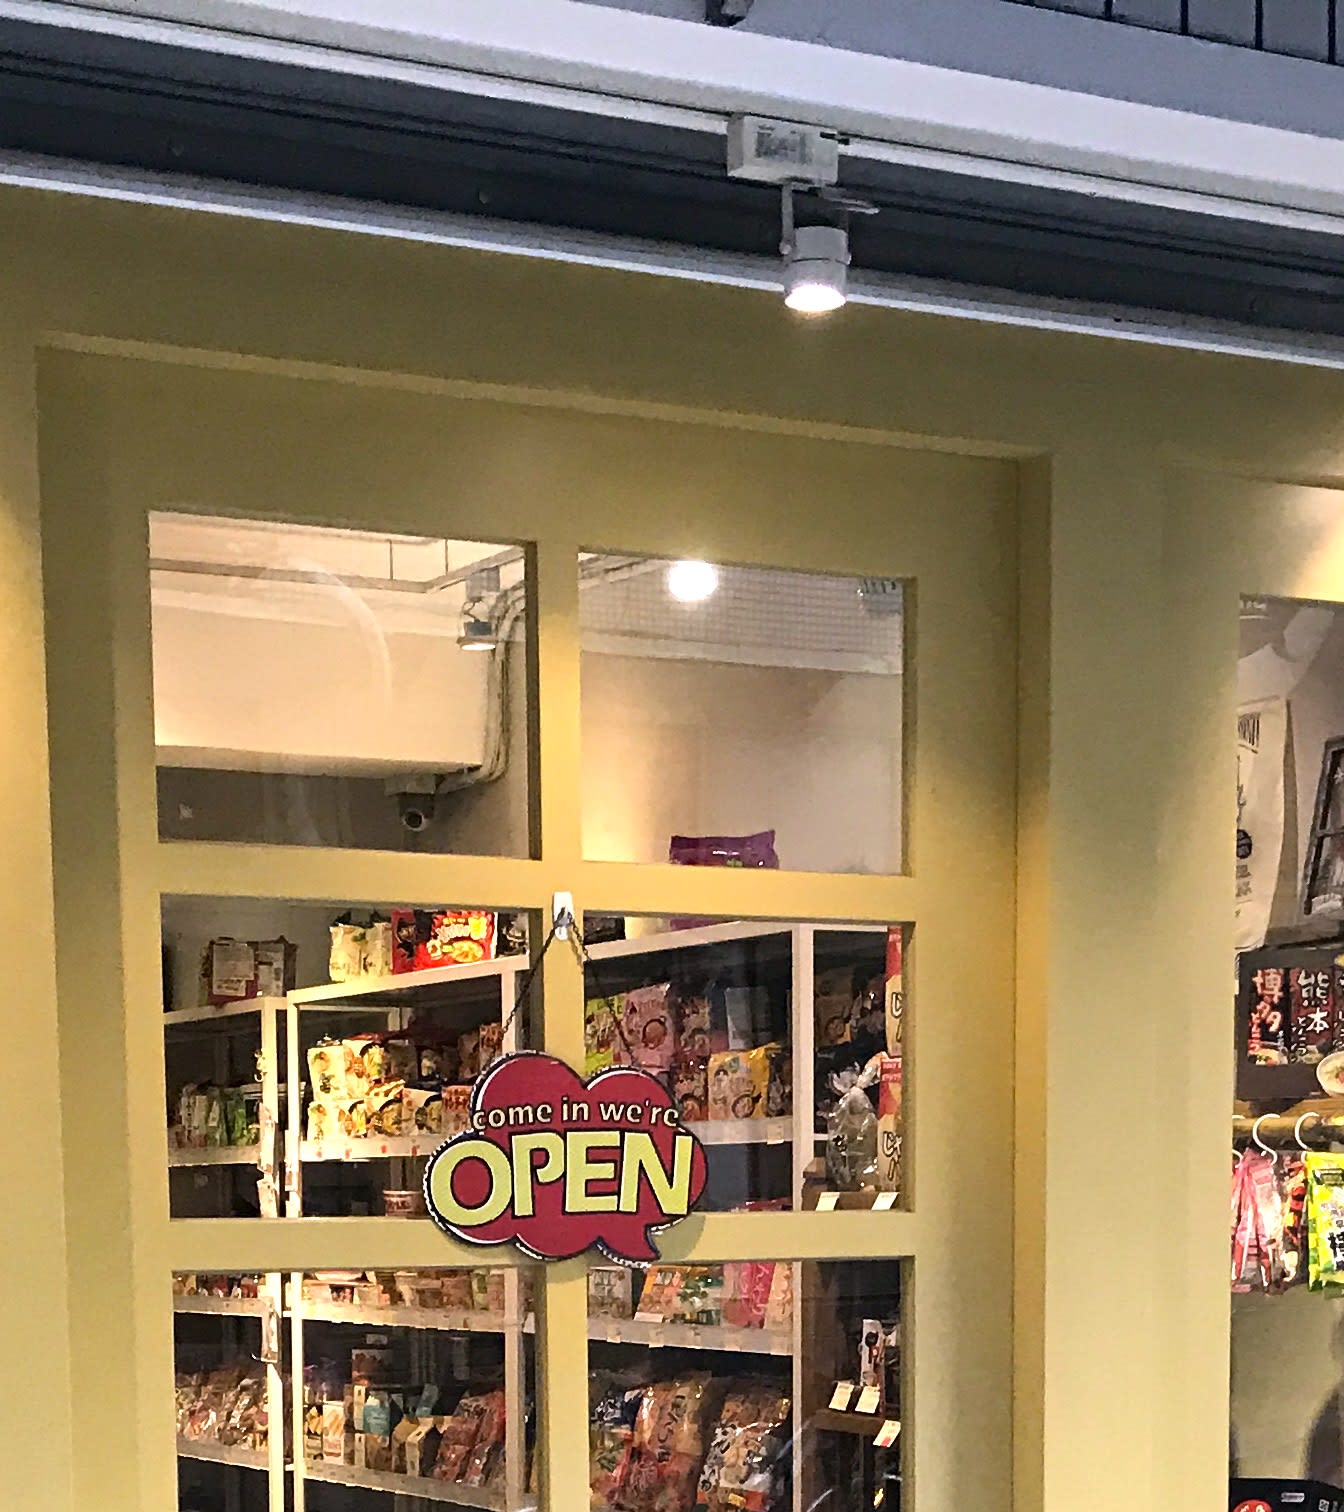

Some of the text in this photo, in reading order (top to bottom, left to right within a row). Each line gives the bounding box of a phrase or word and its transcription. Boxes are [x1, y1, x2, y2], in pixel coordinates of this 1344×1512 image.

[1297, 969, 1329, 1034] 熊本
[472, 1096, 679, 1130] come in we're
[430, 1130, 693, 1226] OPEN
